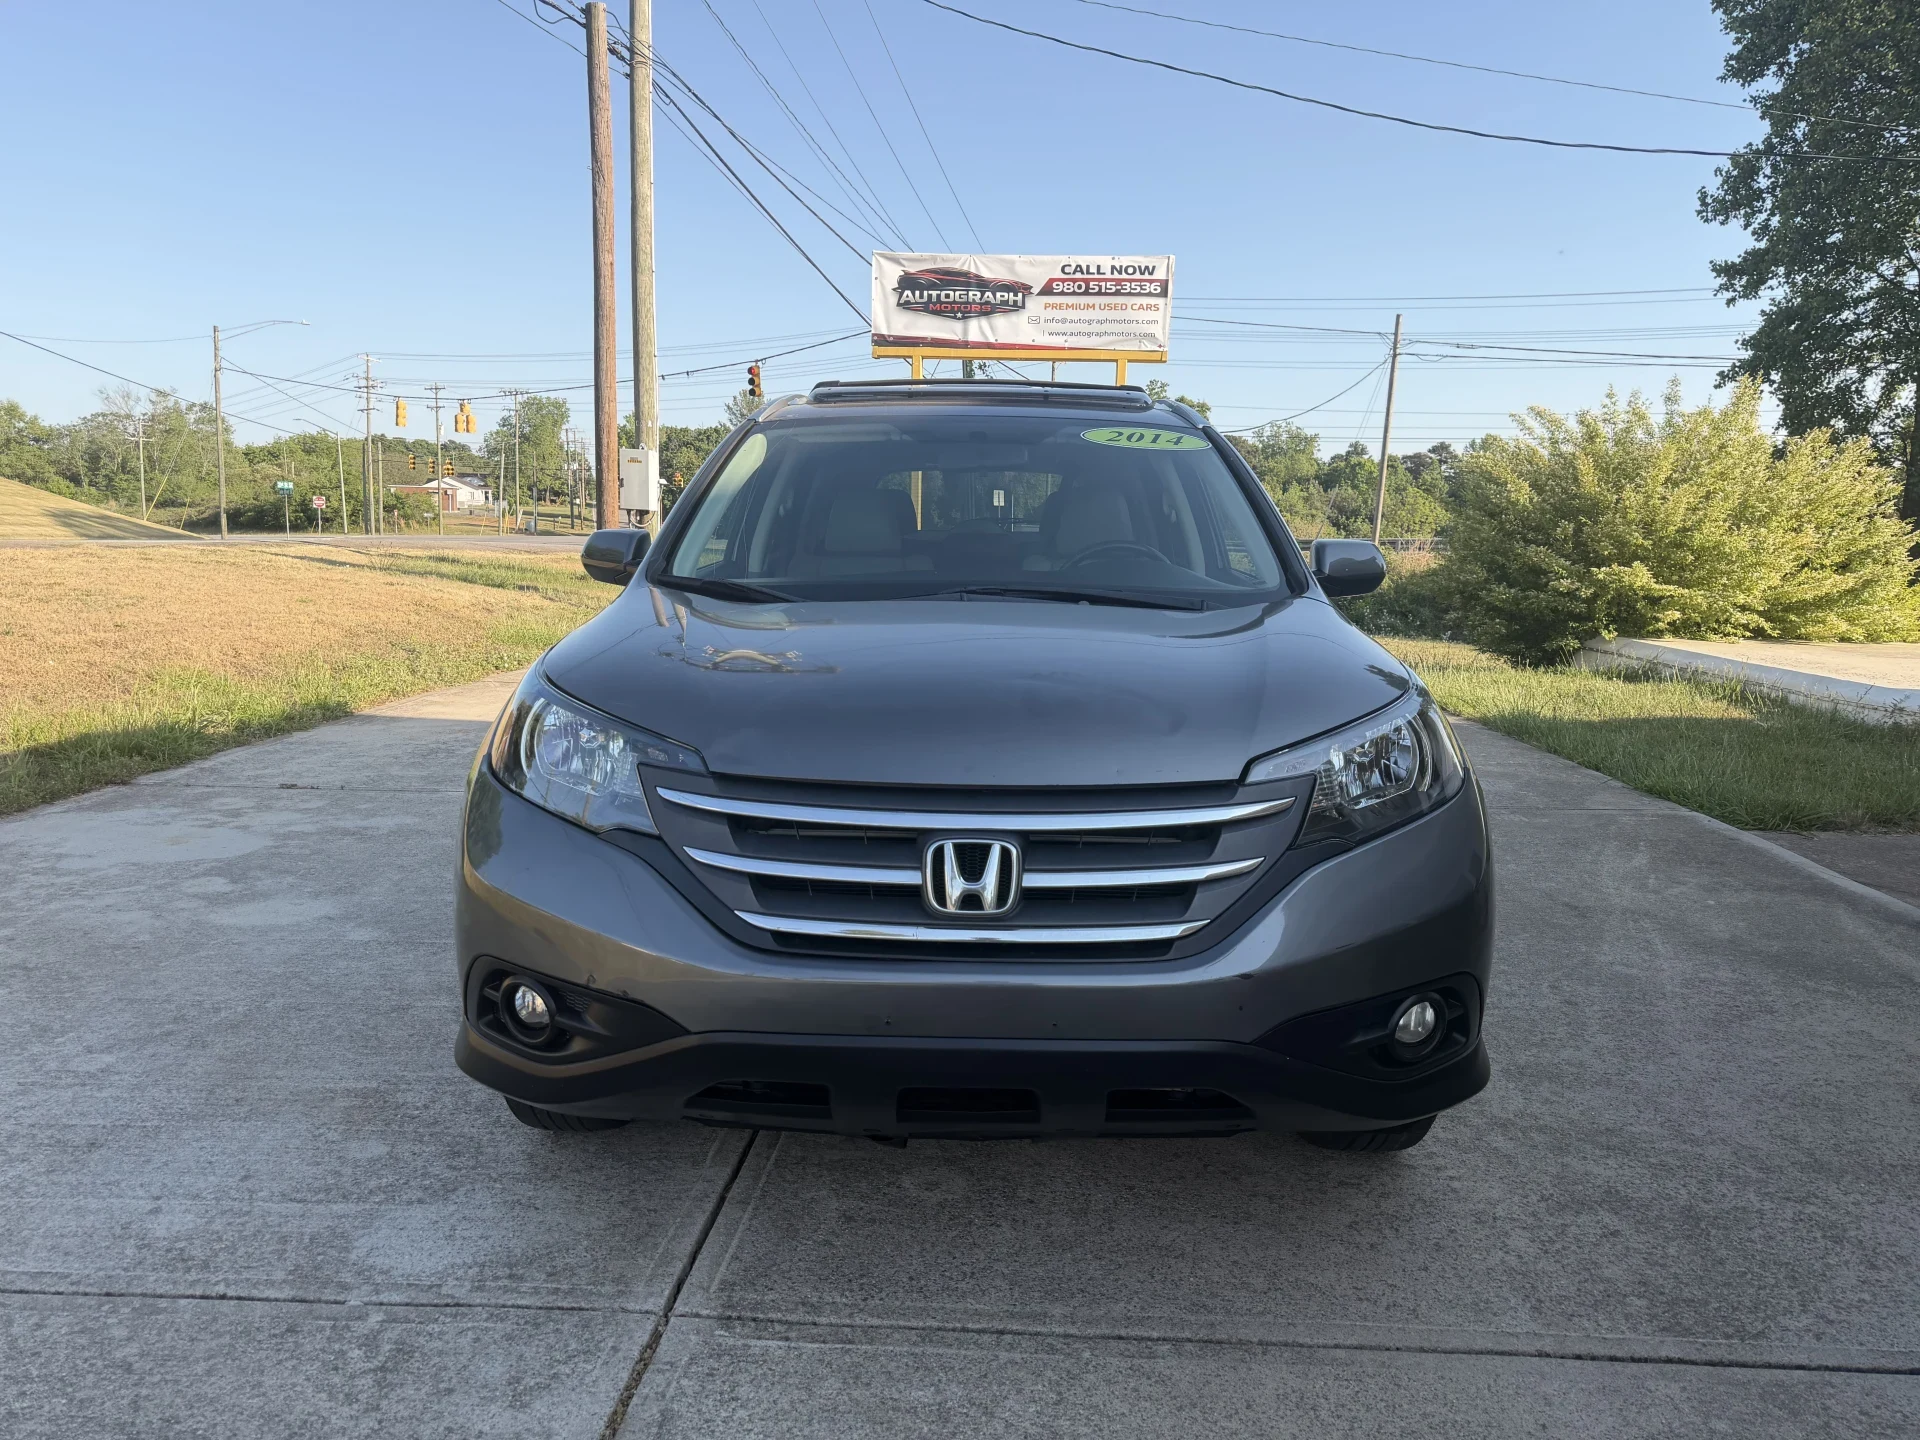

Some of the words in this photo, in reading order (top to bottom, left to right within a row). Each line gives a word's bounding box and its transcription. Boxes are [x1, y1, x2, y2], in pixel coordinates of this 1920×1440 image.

[1060, 264, 1106, 276] CALL
[1110, 264, 1157, 276] NOW
[1052, 281, 1085, 293] 980
[1088, 281, 1162, 294] 515-3536
[900, 289, 1023, 307] AUTOGRAPH
[929, 303, 992, 312] MOTORS
[1044, 302, 1096, 311] PREMIUM
[1098, 302, 1128, 311] USED
[1130, 303, 1160, 312] CARS
[1043, 317, 1159, 326] info@autographmotors.com
[1047, 330, 1156, 338] www.autographmotors.com
[1105, 431, 1184, 446] 2014
